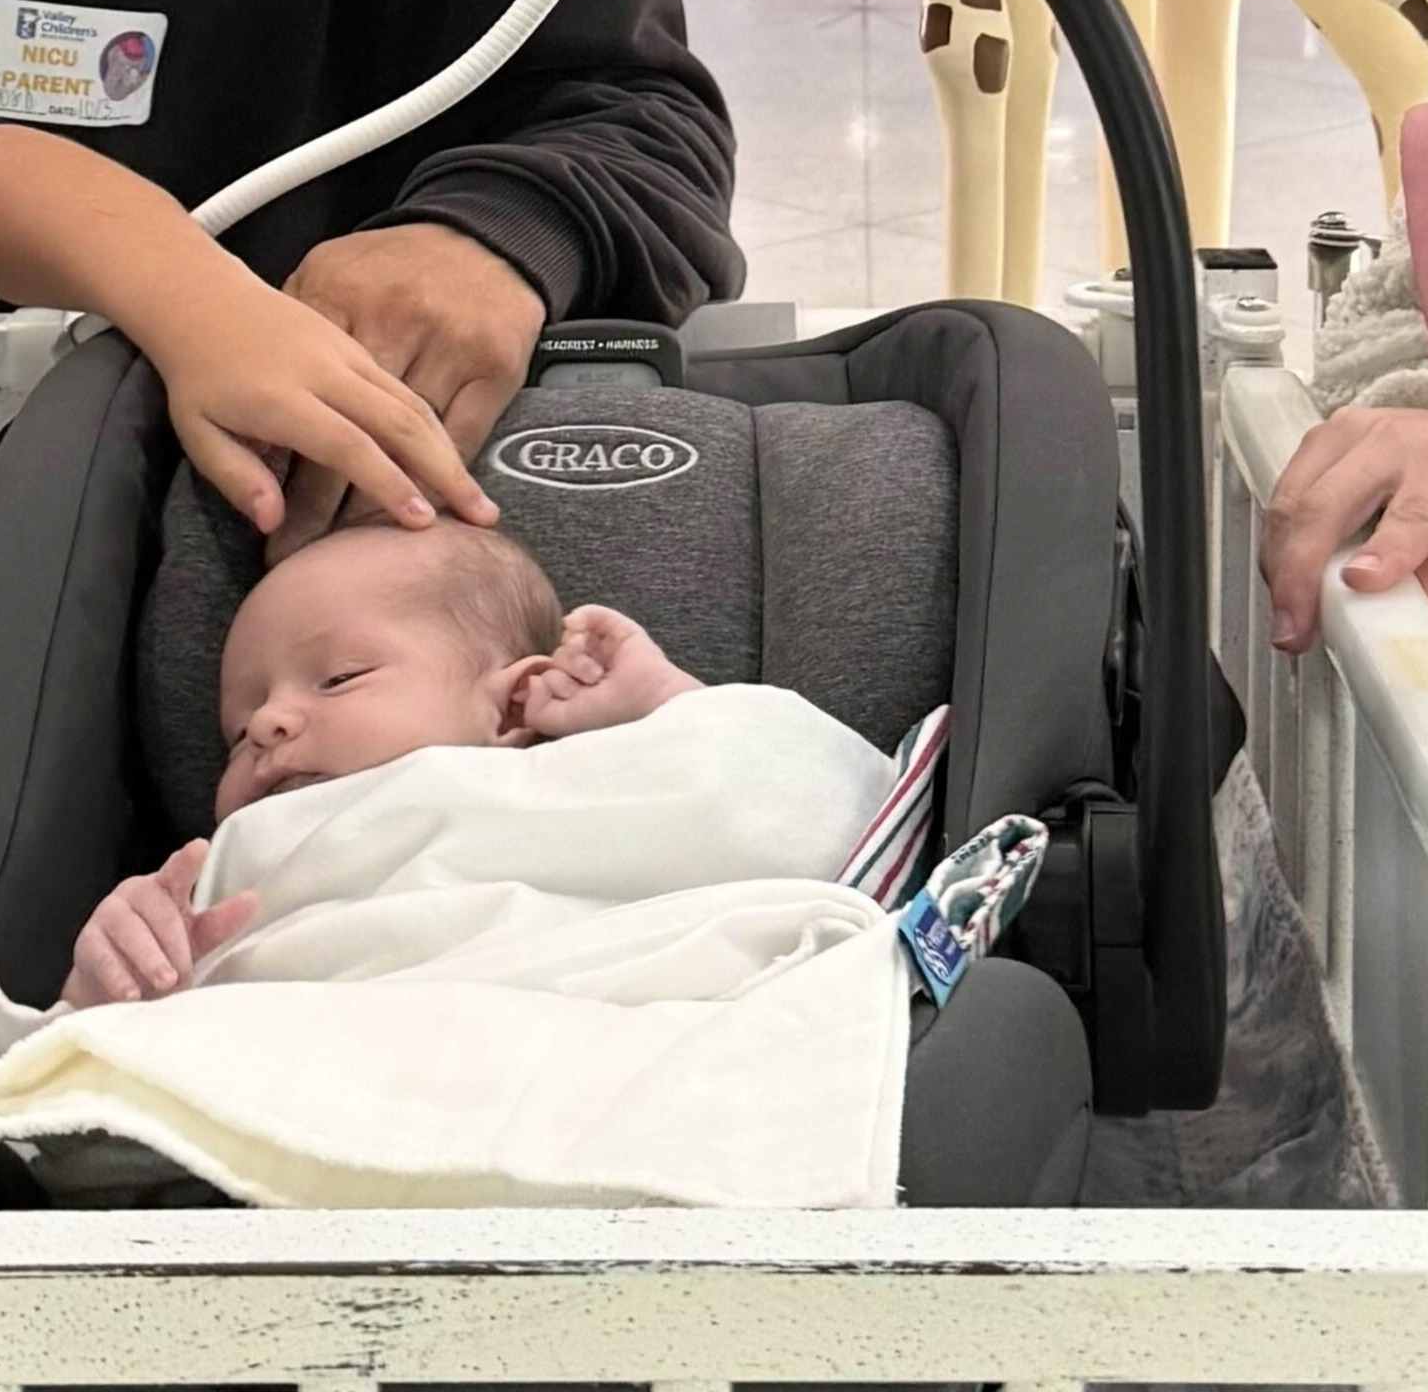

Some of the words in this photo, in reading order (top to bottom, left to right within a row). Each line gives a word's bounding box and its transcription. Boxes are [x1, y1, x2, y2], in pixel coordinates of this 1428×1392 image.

[40, 21, 98, 39] Children's
[41, 10, 77, 27] Valley
[22, 44, 79, 68] NICU
[1, 70, 96, 97] PARENT
[521, 439, 675, 472] GRACO
